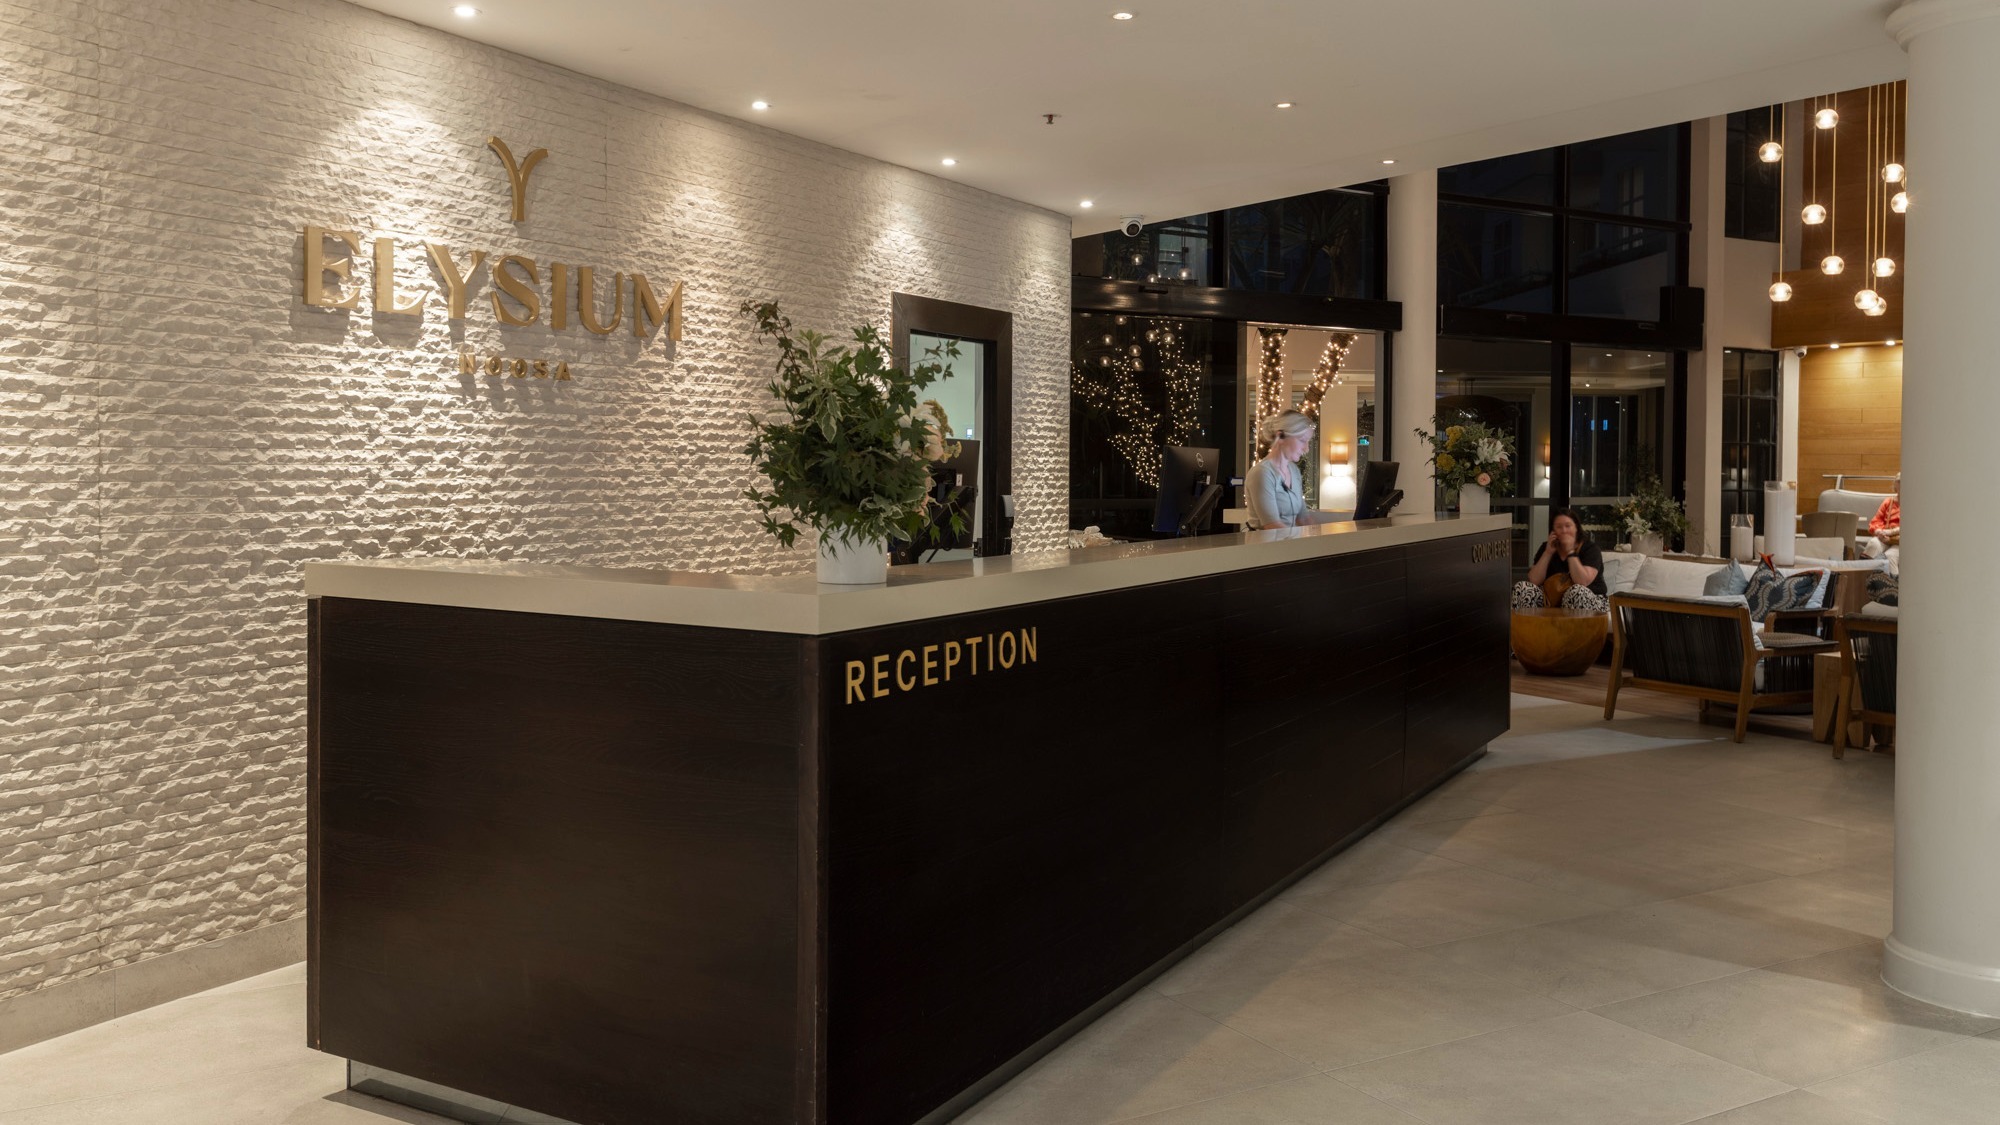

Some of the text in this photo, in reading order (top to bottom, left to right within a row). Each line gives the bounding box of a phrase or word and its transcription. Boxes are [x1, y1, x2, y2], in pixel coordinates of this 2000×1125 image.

[303, 226, 683, 341] ELYSIUM
[459, 352, 571, 381] NOOSA
[1472, 539, 1509, 563] CONCIERGE
[846, 626, 1037, 704] RECEPTION
